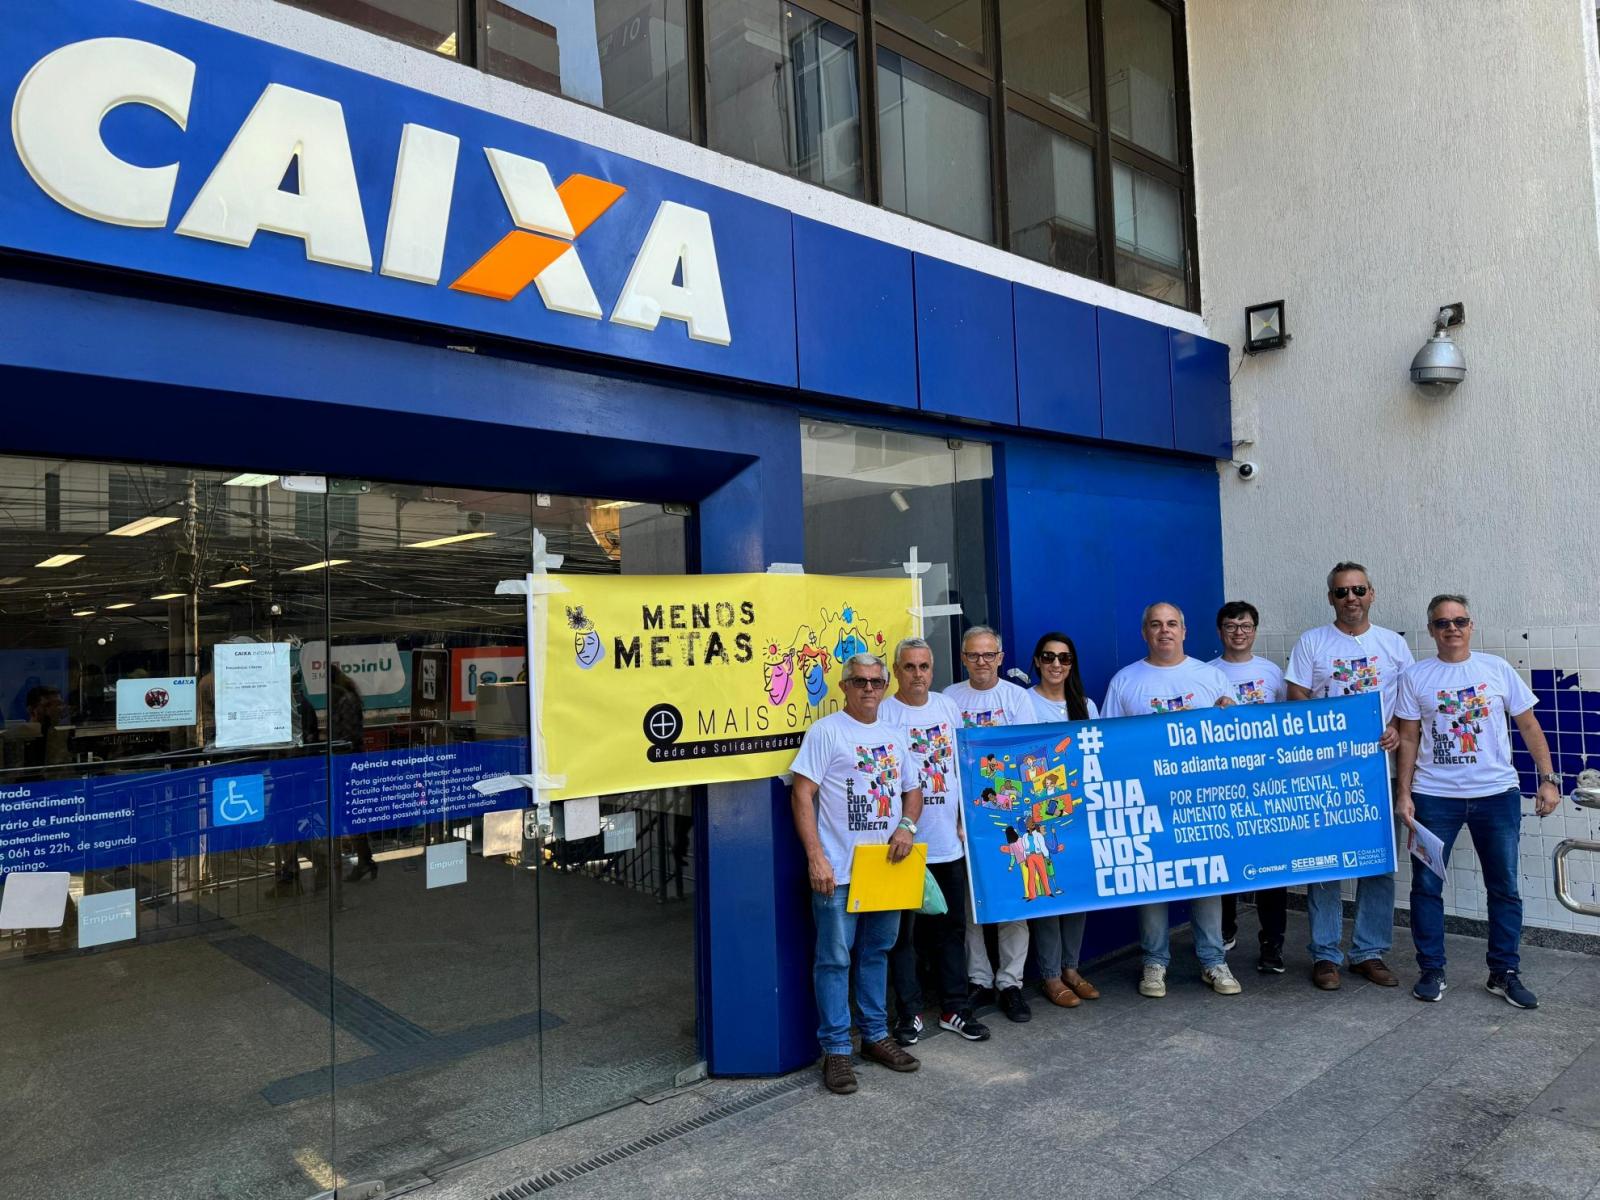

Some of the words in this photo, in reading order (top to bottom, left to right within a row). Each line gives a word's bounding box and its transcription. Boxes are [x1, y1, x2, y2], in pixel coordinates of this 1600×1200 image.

[11, 37, 731, 346] CAIXA
[642, 601, 755, 630] MENOS
[614, 632, 753, 669] METAS
[698, 706, 769, 735] MAIS
[786, 695, 847, 727] SAÚD
[1167, 720, 1197, 747] Dia
[1200, 713, 1279, 744] Nacional
[1283, 712, 1303, 736] de
[1307, 710, 1347, 733] Luta
[655, 747, 685, 758] Rede
[693, 745, 707, 755] de
[714, 737, 794, 753] Solidariedade
[1153, 759, 1178, 776] Não
[1181, 756, 1228, 774] adianta
[1232, 752, 1266, 772] negar
[1277, 745, 1313, 764] Saúde
[1316, 746, 1334, 760] em
[1350, 740, 1379, 759] lugar
[351, 759, 388, 771] Agência
[391, 753, 434, 766] equipada
[436, 753, 457, 762] com:
[1083, 755, 1104, 783] A
[1433, 756, 1477, 764] CONECTA
[351, 778, 371, 786] Porta
[372, 774, 404, 785] giratória
[422, 769, 451, 779] detector
[462, 763, 482, 773] metal
[351, 787, 380, 796] Circuito
[382, 783, 411, 793] fechado
[351, 796, 378, 806] Alarme
[380, 792, 419, 802] interligado
[847, 795, 867, 804] SUA
[923, 796, 945, 805] ECTA
[1084, 779, 1146, 812] SUA
[1170, 790, 1192, 807] POR
[1196, 784, 1249, 804] EMPREGO,
[1252, 778, 1287, 797] SAÚDE
[1291, 774, 1338, 794] MENTAL,
[351, 807, 372, 816] Cofre
[392, 799, 428, 811] fechadura
[430, 797, 439, 805] de
[440, 793, 466, 803] retardo
[352, 816, 366, 825] não
[368, 814, 391, 823] sendo
[393, 807, 421, 820] possível
[437, 804, 466, 813] abertura
[848, 804, 872, 813] LUTA
[1172, 804, 1227, 825] AUMENTO
[1230, 802, 1262, 819] REAL,
[1265, 791, 1341, 816] MANUTENÇÃO
[1345, 789, 1366, 806] DOS
[32, 817, 47, 827] de
[50, 809, 135, 826] Funcionamento:
[848, 813, 868, 822] NOS
[849, 821, 888, 831] CONECTA
[1087, 805, 1164, 839] LUTA
[1175, 823, 1234, 844] DIREITOS,
[1237, 814, 1310, 837] DIVERSIDADE
[1314, 813, 1321, 828] E
[1324, 803, 1382, 825] INCLUSÃO.
[8, 847, 30, 859] 06h
[33, 846, 46, 856] às
[49, 843, 74, 855] 22h,
[77, 841, 91, 851] de
[94, 835, 137, 849] segunda
[1091, 834, 1153, 868] NOS
[429, 858, 464, 870] Empurre
[1096, 855, 1229, 896] CONECTA
